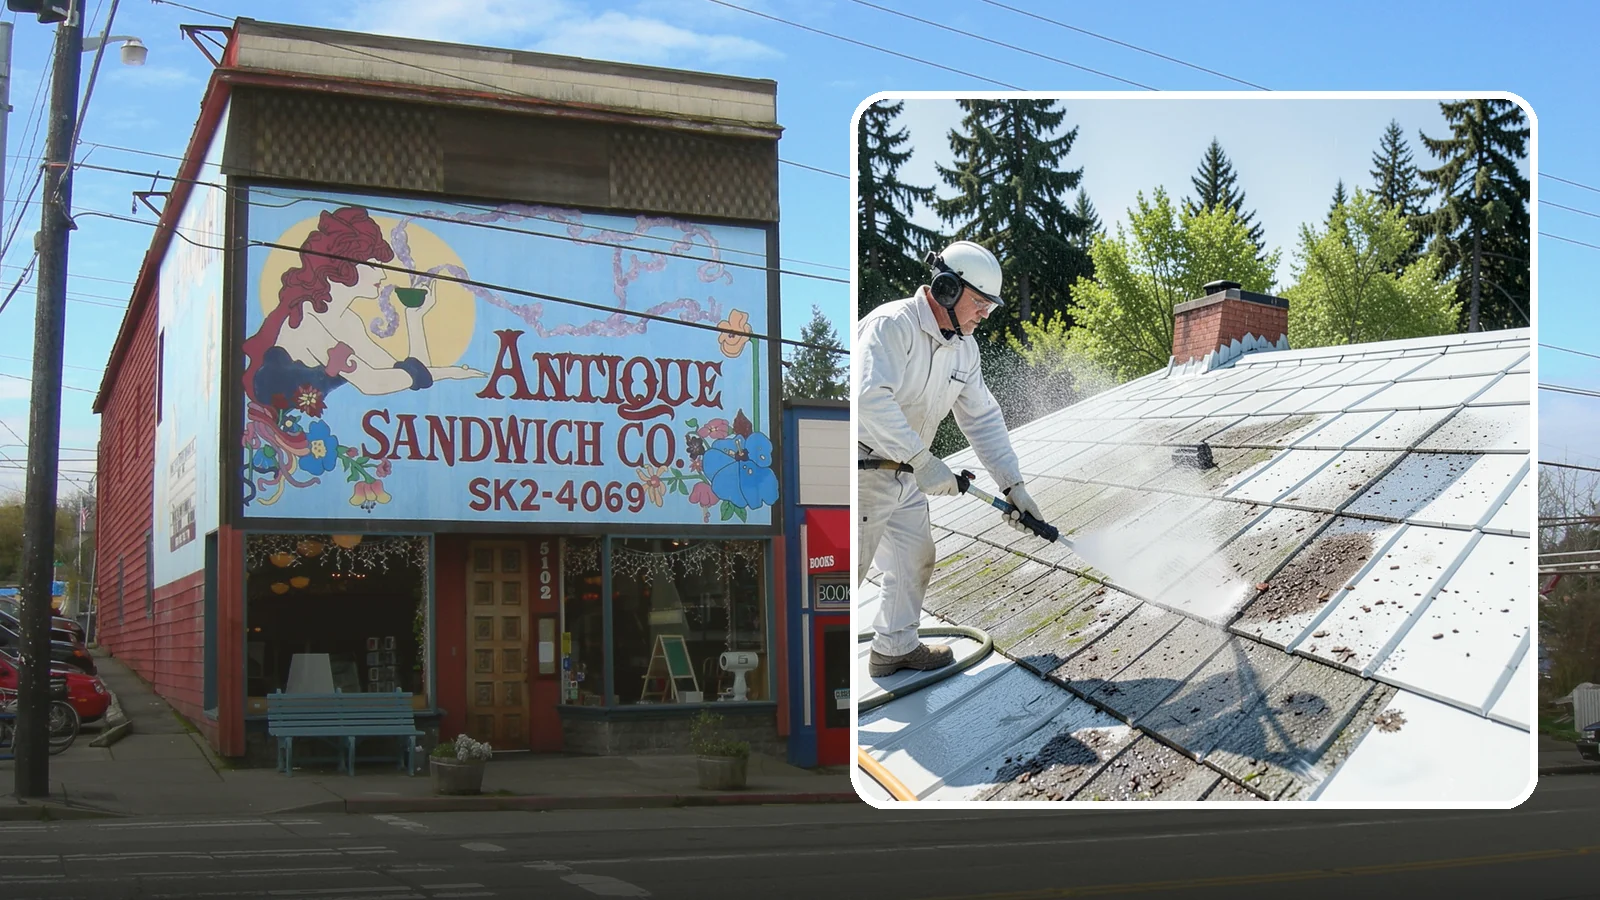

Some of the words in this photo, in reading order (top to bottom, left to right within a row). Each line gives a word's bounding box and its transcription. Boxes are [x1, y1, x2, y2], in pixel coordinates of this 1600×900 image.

[476, 329, 723, 420] ANTIQUE
[362, 409, 605, 467] SANDWICH
[617, 422, 685, 468] CO.
[468, 478, 645, 513] SK2-4069
[540, 542, 551, 599] 5102
[809, 555, 835, 569] BOOKS
